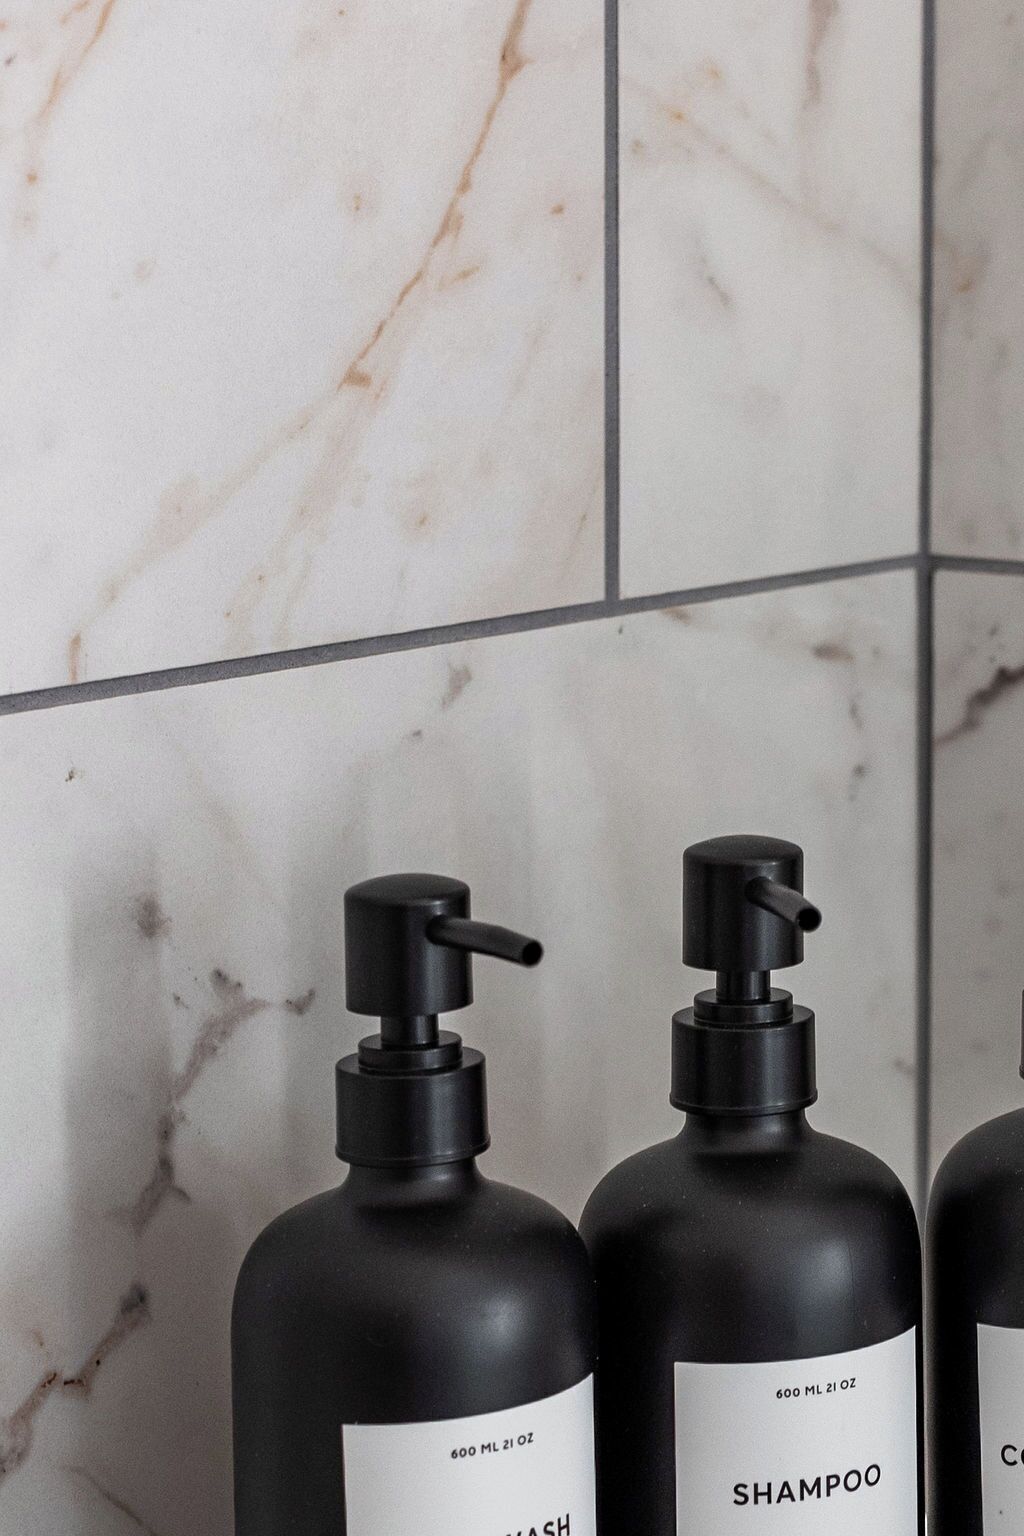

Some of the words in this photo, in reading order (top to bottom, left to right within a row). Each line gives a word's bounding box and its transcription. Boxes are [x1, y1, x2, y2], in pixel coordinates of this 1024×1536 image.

[775, 1386, 801, 1400] 600
[804, 1383, 823, 1397] ML
[825, 1381, 837, 1394] 21
[839, 1376, 857, 1391] OZ
[450, 1445, 477, 1460] 600
[480, 1441, 500, 1455] ML
[502, 1437, 514, 1451] 21
[516, 1431, 534, 1446] OZ
[732, 1463, 882, 1507] SHAMPOO
